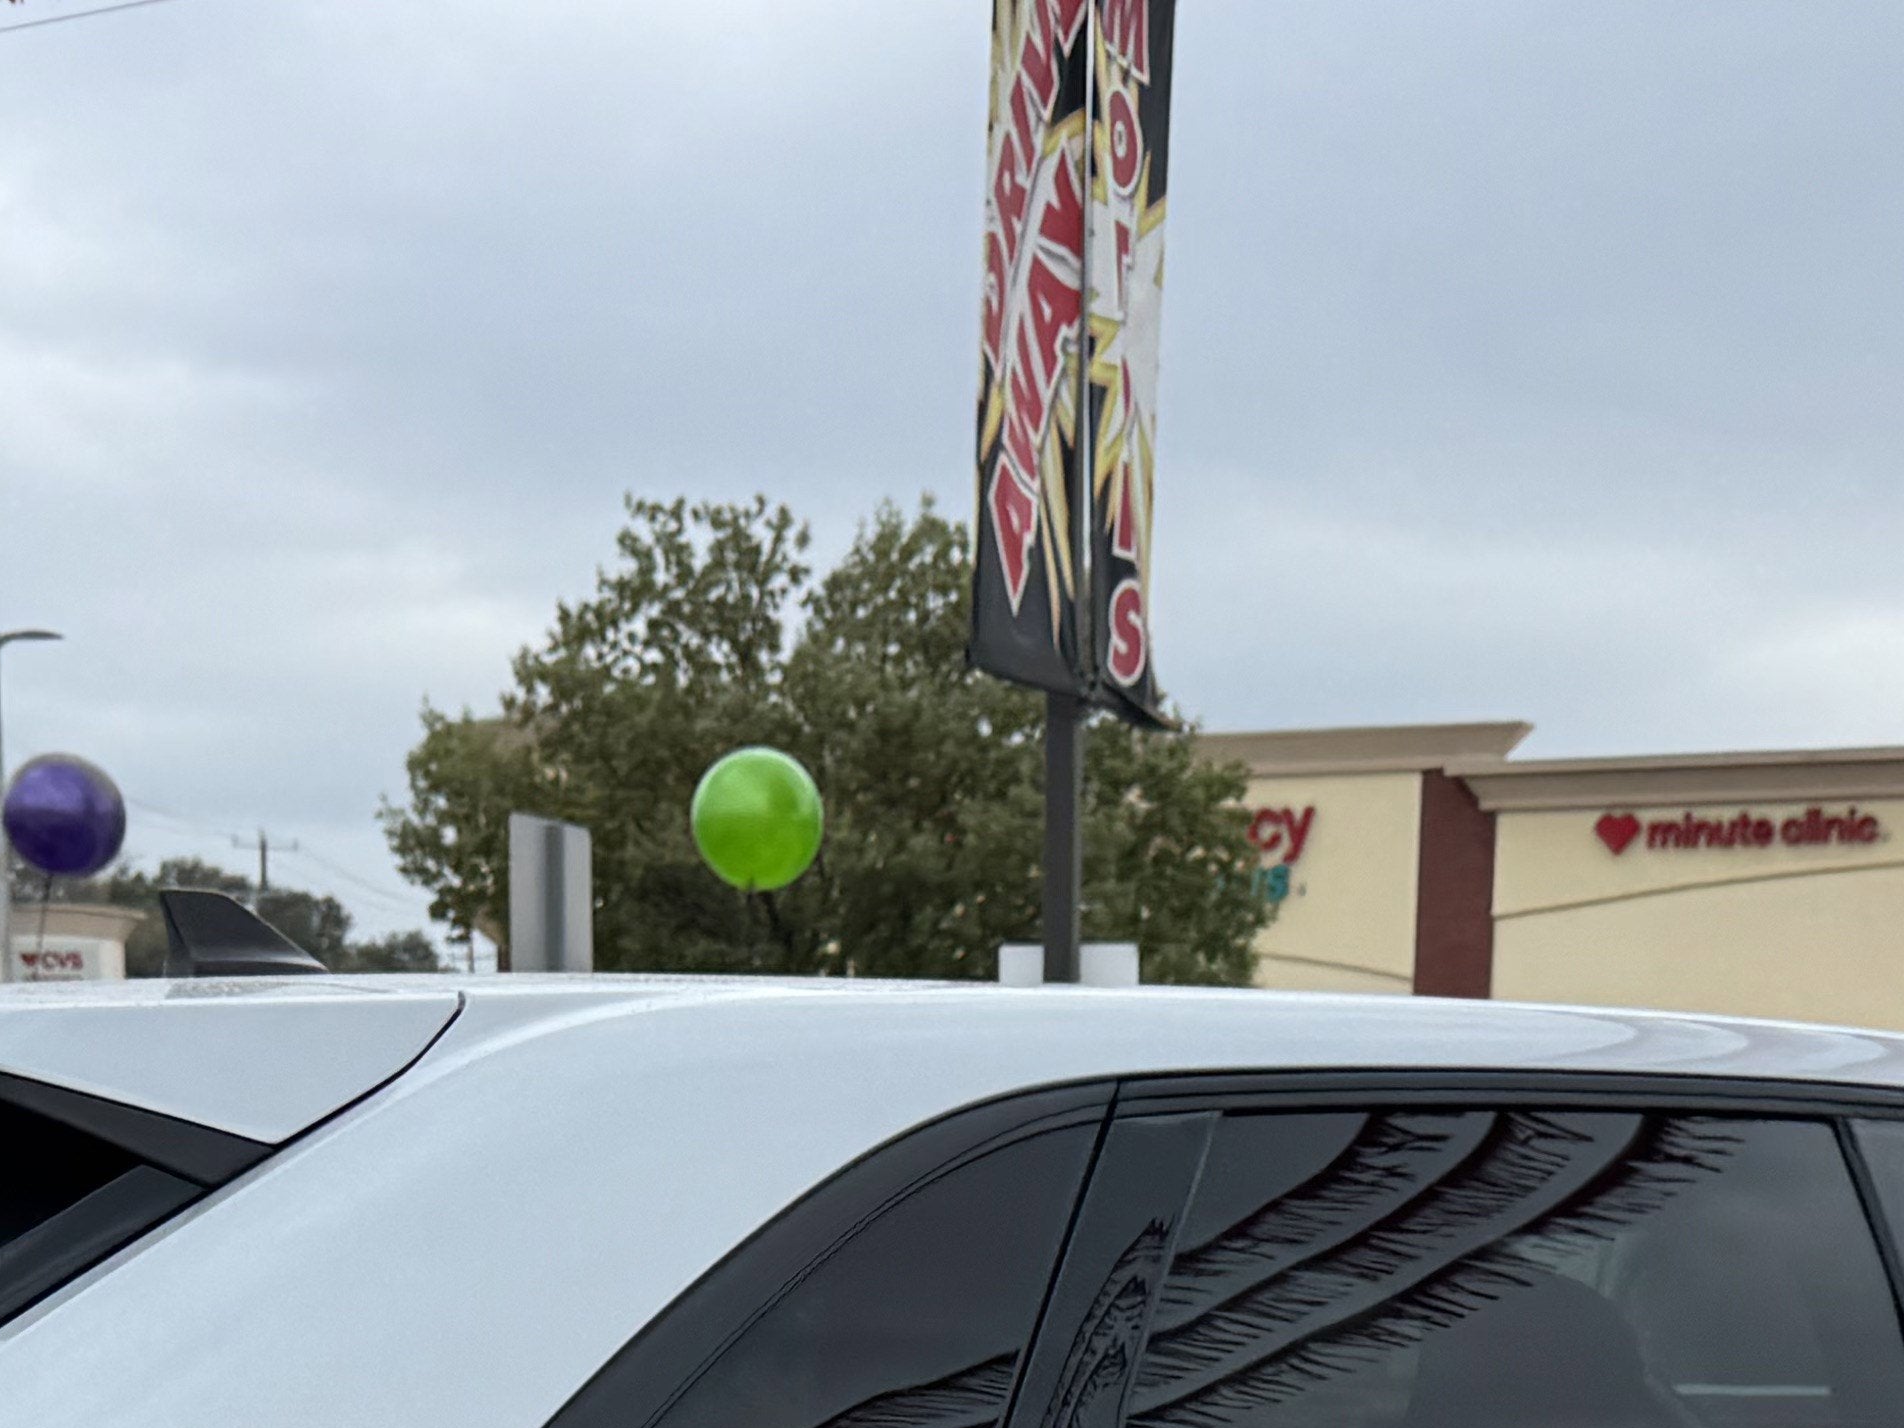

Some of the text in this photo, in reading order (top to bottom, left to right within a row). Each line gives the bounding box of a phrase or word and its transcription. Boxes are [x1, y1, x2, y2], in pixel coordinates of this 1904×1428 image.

[1648, 806, 1879, 850] minute clinic
[41, 951, 83, 970] CVS
